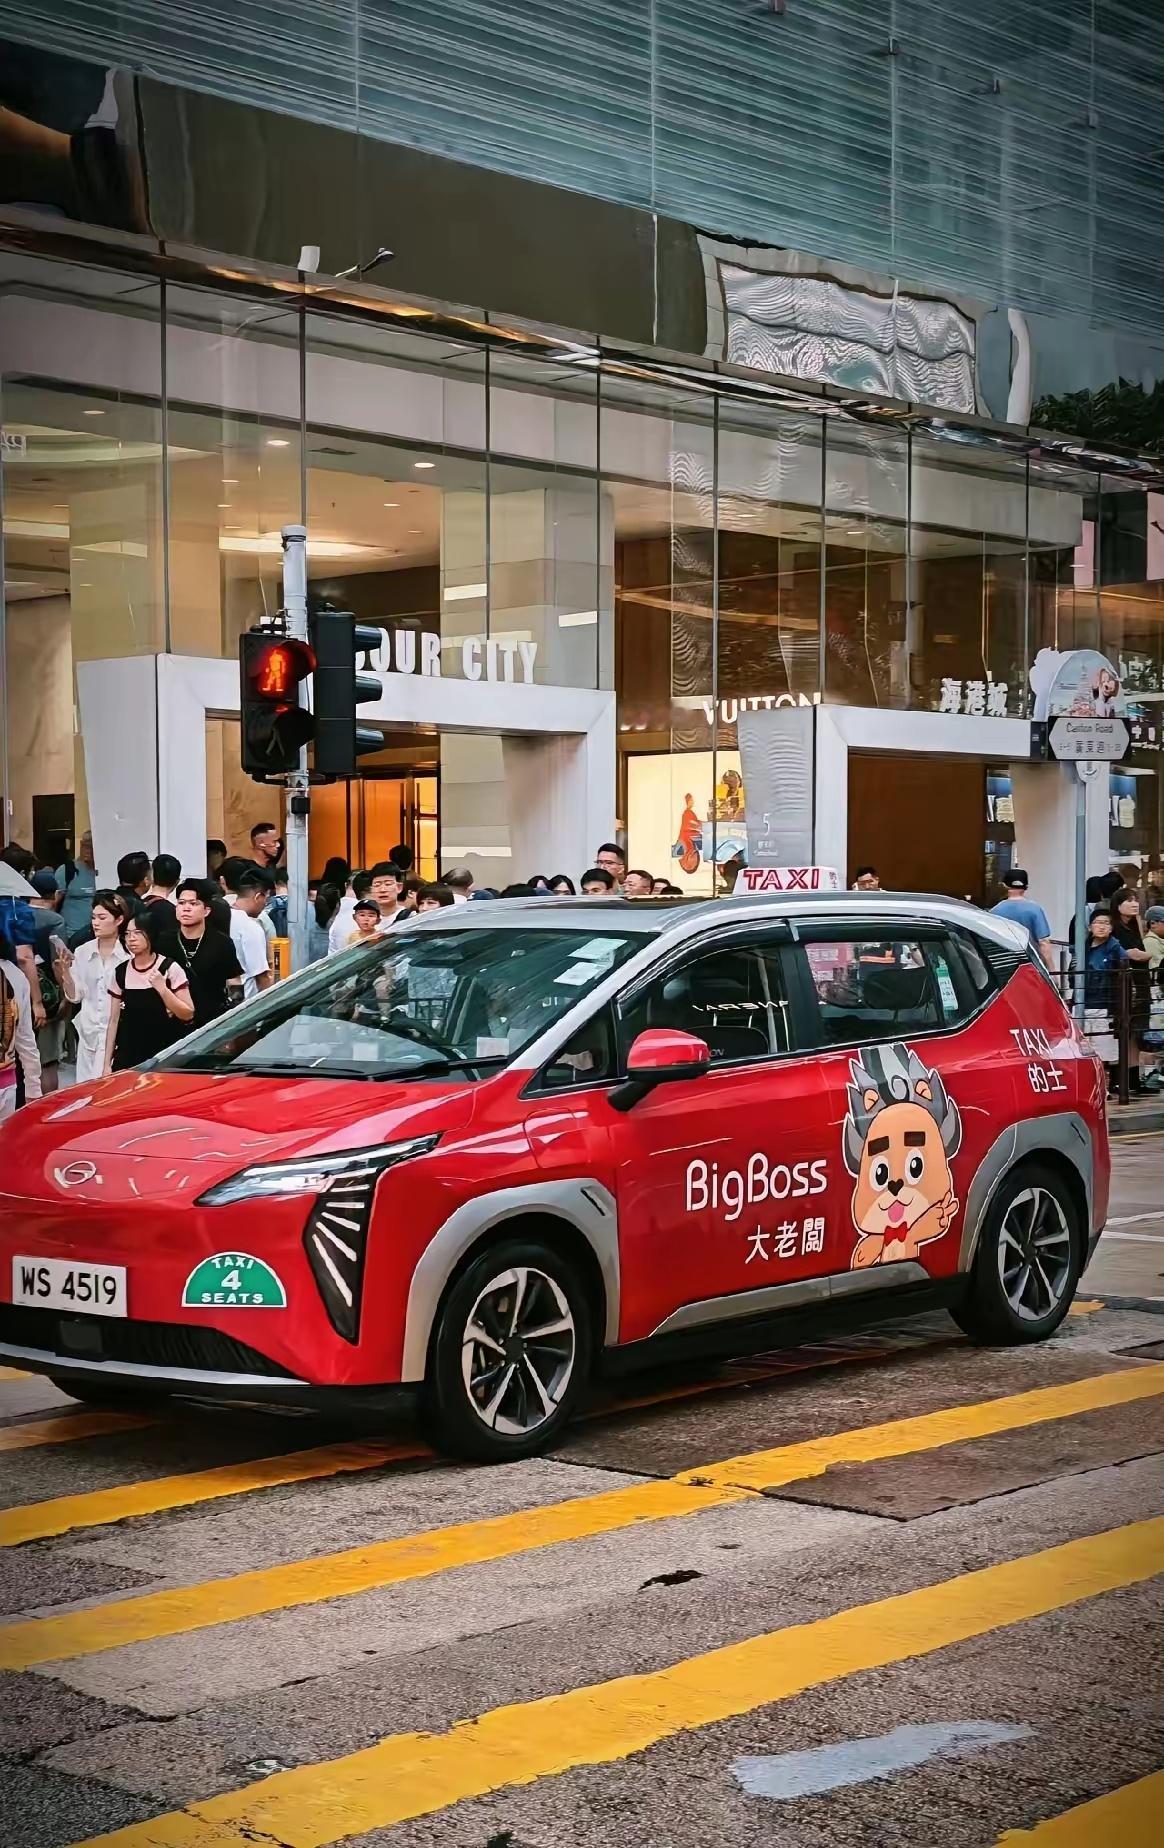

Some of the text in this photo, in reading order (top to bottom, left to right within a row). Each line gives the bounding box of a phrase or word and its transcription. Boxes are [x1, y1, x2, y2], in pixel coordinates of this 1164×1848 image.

[356, 627, 538, 684] OUR CITY
[939, 677, 1008, 718] 海港城
[743, 868, 820, 891] TAXI
[1009, 1028, 1053, 1057] TAXI
[1027, 1061, 1068, 1093] 的士
[686, 1152, 828, 1221] BigBoss
[744, 1216, 826, 1265] 大老闆
[211, 1256, 255, 1270] TAXI
[21, 1266, 117, 1305] WS 4519
[220, 1269, 242, 1291] 4
[201, 1292, 264, 1304] SEATS
